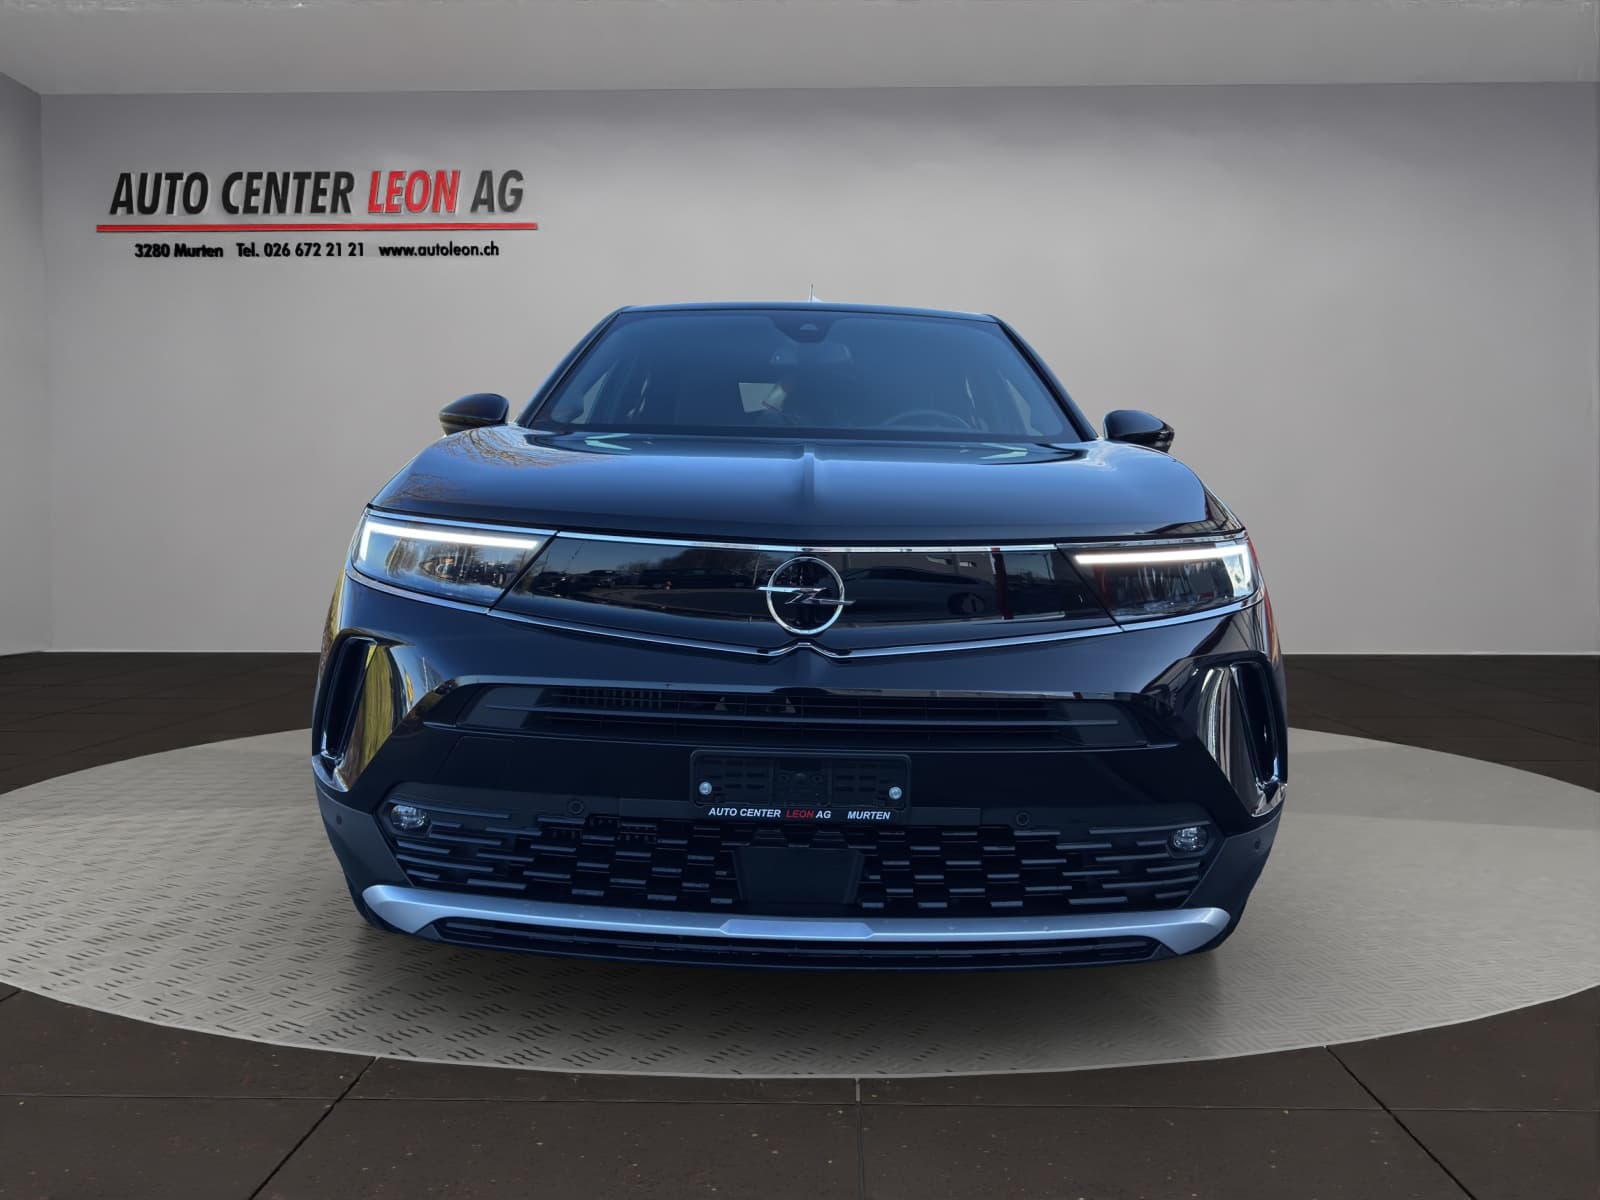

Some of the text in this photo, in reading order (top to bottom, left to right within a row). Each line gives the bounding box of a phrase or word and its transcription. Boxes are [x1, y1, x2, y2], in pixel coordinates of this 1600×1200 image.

[110, 169, 524, 215] AUTO CENTER LEON AG
[134, 241, 499, 258] 3280 Murten Tel. 026 672 21 21 www.autoleon.ch
[708, 807, 891, 820] AUTO CENTER LEON AG MURTEN
